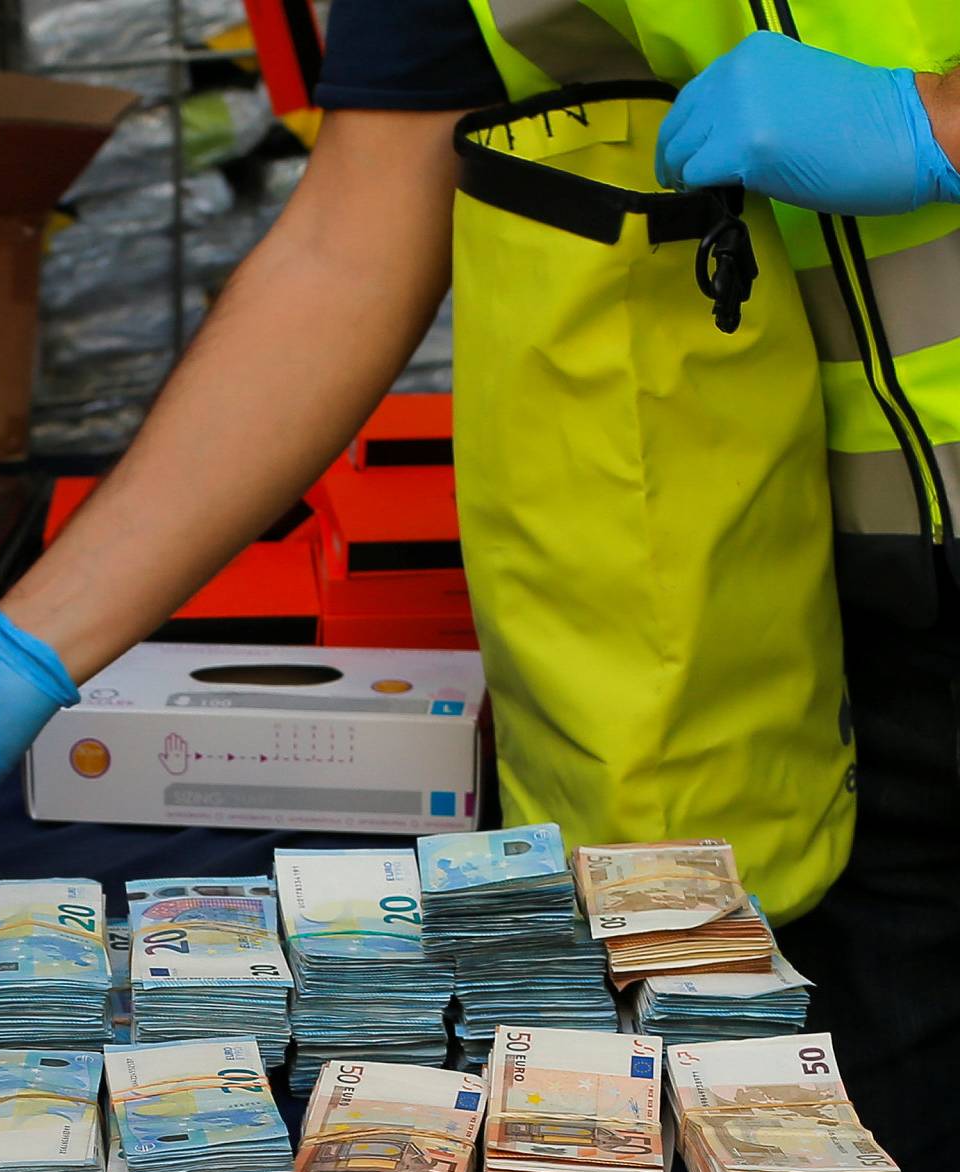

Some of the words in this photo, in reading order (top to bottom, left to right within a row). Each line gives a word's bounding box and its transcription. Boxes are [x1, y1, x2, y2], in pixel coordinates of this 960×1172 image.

[384, 861, 395, 882] EURO
[57, 903, 96, 933] 20
[378, 895, 422, 925] 20
[599, 915, 627, 931] 50
[143, 929, 190, 956] 20
[250, 964, 280, 976] 20
[507, 1032, 531, 1052] 50
[225, 1046, 235, 1061] EURO
[798, 1047, 830, 1075] 50
[340, 1064, 364, 1085] 50
[513, 1054, 527, 1082] EURO
[339, 1086, 355, 1108] EURO
[856, 1153, 890, 1167] 50
